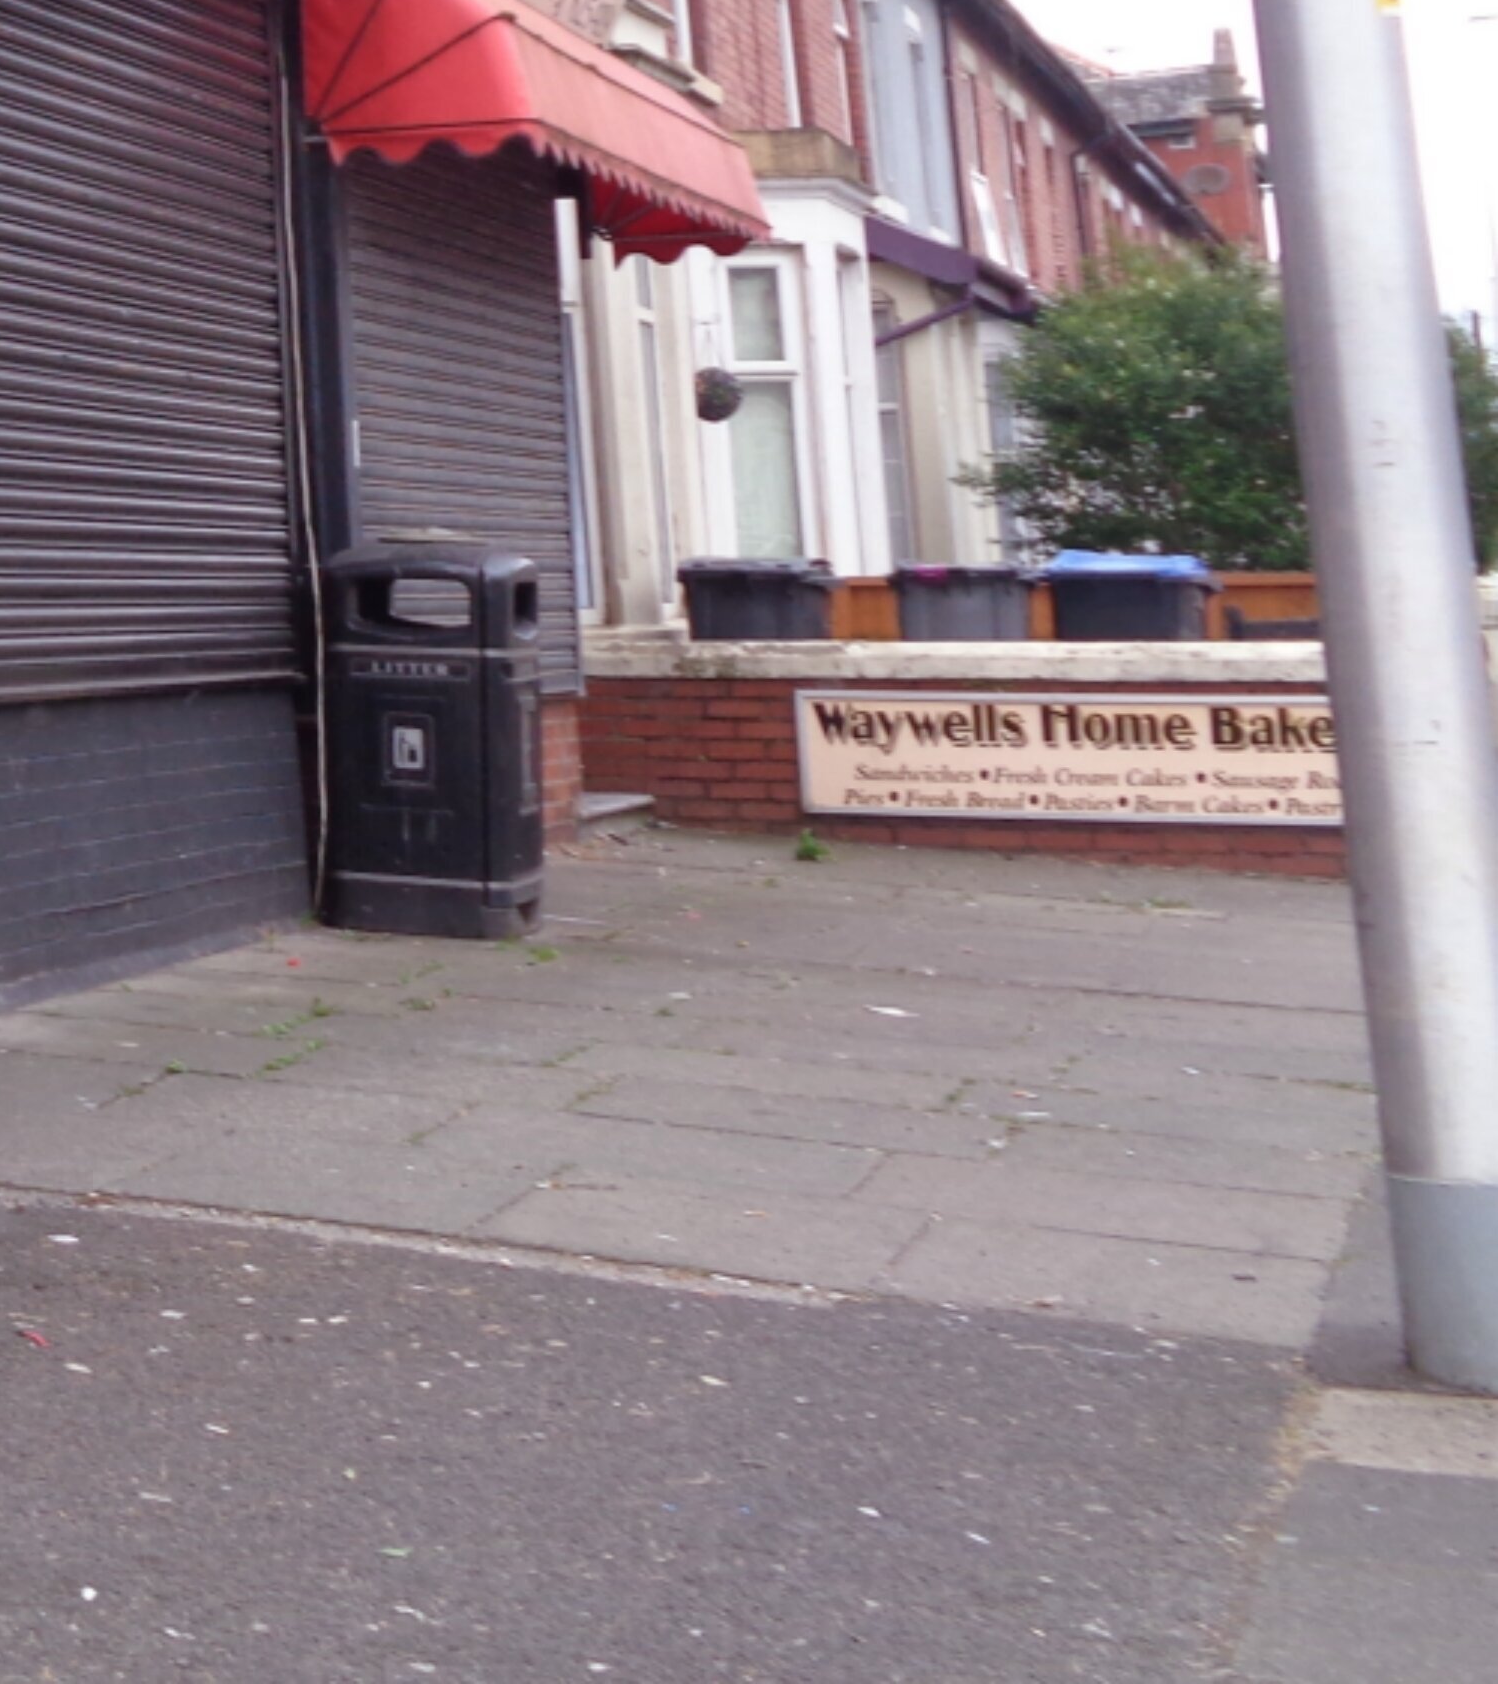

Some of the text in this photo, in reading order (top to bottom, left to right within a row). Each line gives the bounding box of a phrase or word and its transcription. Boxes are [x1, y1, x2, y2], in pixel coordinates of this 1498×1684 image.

[371, 659, 450, 678] LITTER
[813, 702, 1337, 756] Waywells Home Bake
[854, 763, 976, 784] Sandwiches
[993, 766, 1048, 785] Fresh
[1055, 767, 1119, 787] Cream
[1126, 768, 1188, 788] Cakes
[906, 790, 961, 809] Fresh
[967, 791, 1026, 810] Bread
[1201, 796, 1264, 814] Cakes
